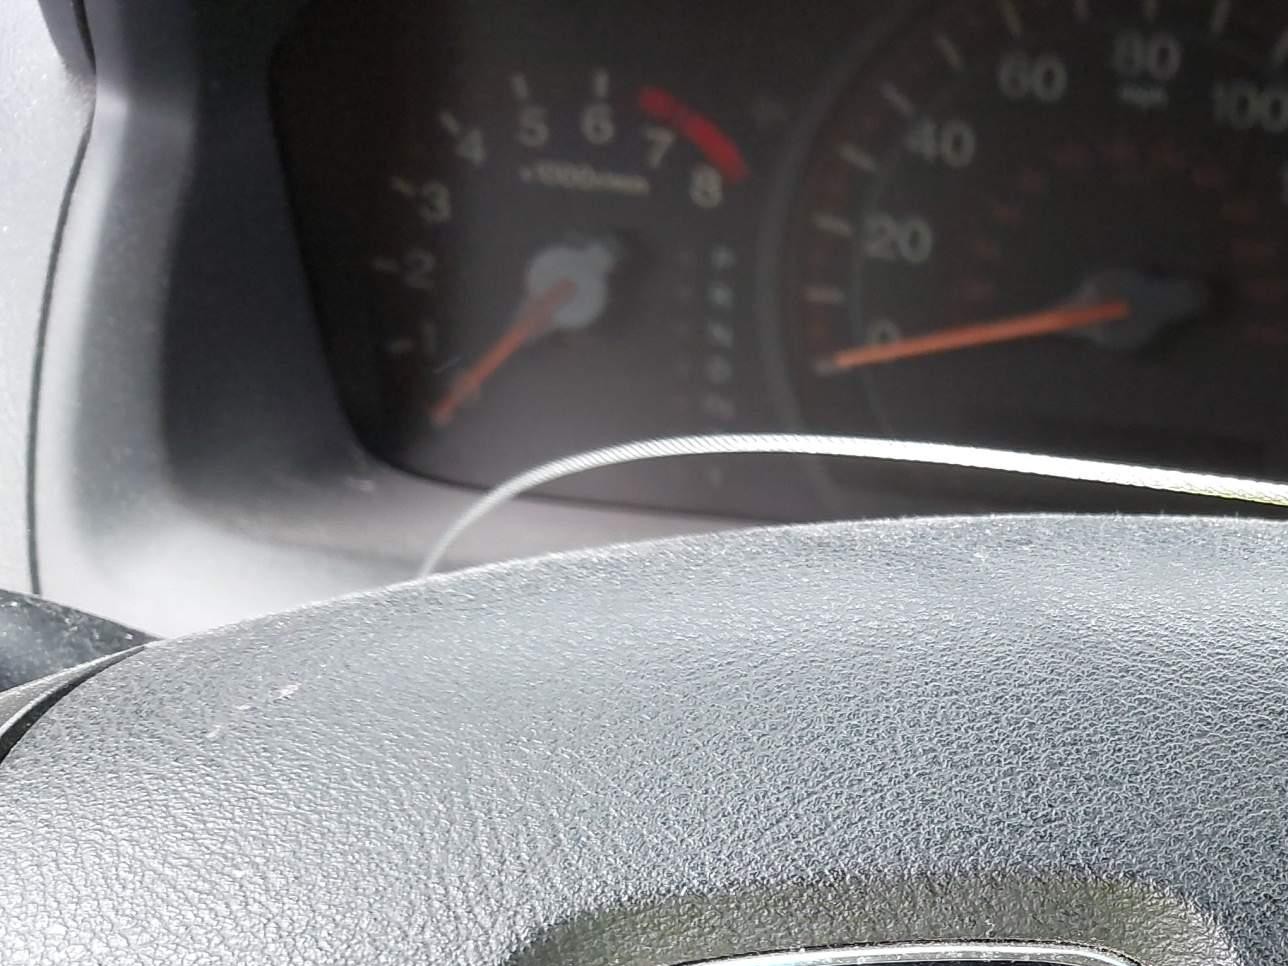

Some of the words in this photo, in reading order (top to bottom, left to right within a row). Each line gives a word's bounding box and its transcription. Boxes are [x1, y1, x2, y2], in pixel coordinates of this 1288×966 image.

[998, 50, 1068, 102] 60
[517, 106, 549, 148] 5
[582, 104, 614, 144] 6
[906, 120, 976, 168] 40
[454, 129, 487, 165] 4
[643, 127, 674, 168] 7
[418, 182, 453, 223] 3
[688, 164, 724, 208] 8
[862, 214, 934, 263] 20
[402, 250, 436, 290] 2
